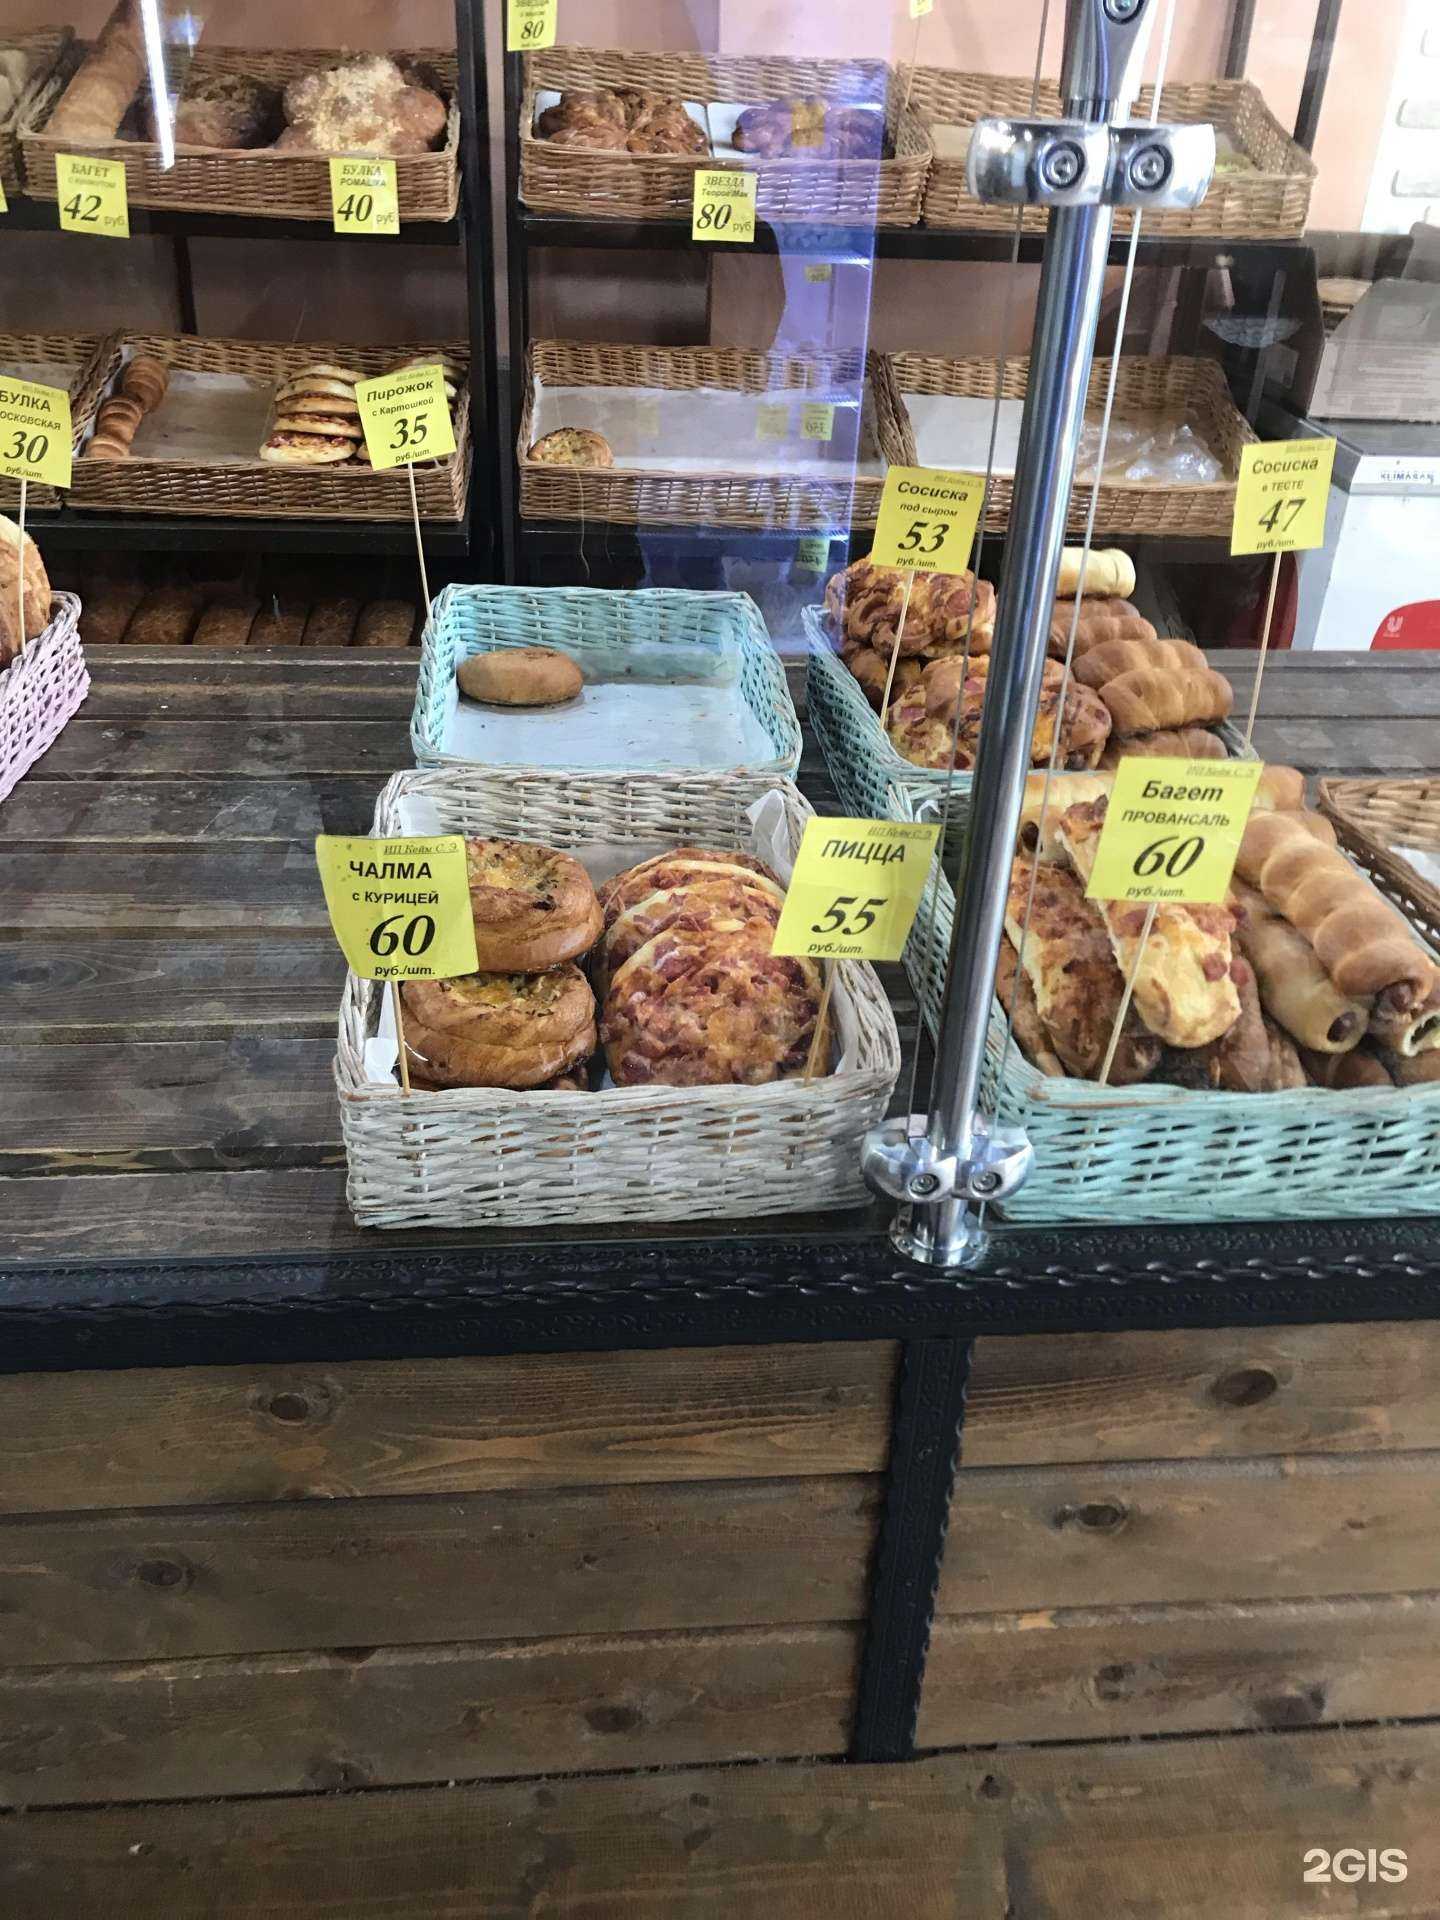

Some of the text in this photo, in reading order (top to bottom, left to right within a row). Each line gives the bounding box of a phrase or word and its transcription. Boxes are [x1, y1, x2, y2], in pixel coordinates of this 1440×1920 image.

[520, 20, 544, 39] 80
[71, 163, 110, 178] БАГЕТ
[343, 164, 382, 176] БУЛКА
[340, 177, 387, 187] РОМАШКА
[704, 176, 745, 187] ЗВЕЗДА
[63, 193, 102, 222] 42
[337, 194, 373, 222] 40
[696, 203, 732, 230] 80
[0, 389, 52, 412] БУЛКА
[366, 380, 434, 403] Пирожок
[371, 395, 434, 417] с Картошкой
[0, 410, 61, 431] ОСКОВСКАЯ
[389, 413, 428, 450] 35
[3, 430, 49, 464] 30
[1251, 457, 1319, 475] Сосиска
[897, 480, 969, 502] Сосиска
[1270, 479, 1305, 493] ТЕСТЕ
[899, 502, 958, 518] под сыром
[1257, 498, 1307, 534] 47
[897, 521, 950, 554] 53
[895, 556, 938, 569] руб./шт.
[1140, 779, 1224, 802] Багет
[1121, 809, 1231, 827] ПРОВАНСАЛЬ
[820, 838, 906, 866] ПИЦЦА
[1132, 835, 1205, 878] 60
[349, 860, 433, 880] ЧАЛМА
[351, 889, 440, 907] с КУРИЦЕЙ
[1125, 885, 1185, 899] руб./шт.
[810, 895, 889, 936] 55
[369, 913, 436, 957] 60
[806, 941, 864, 955] руб./шт.
[374, 964, 437, 978] руб./шт.
